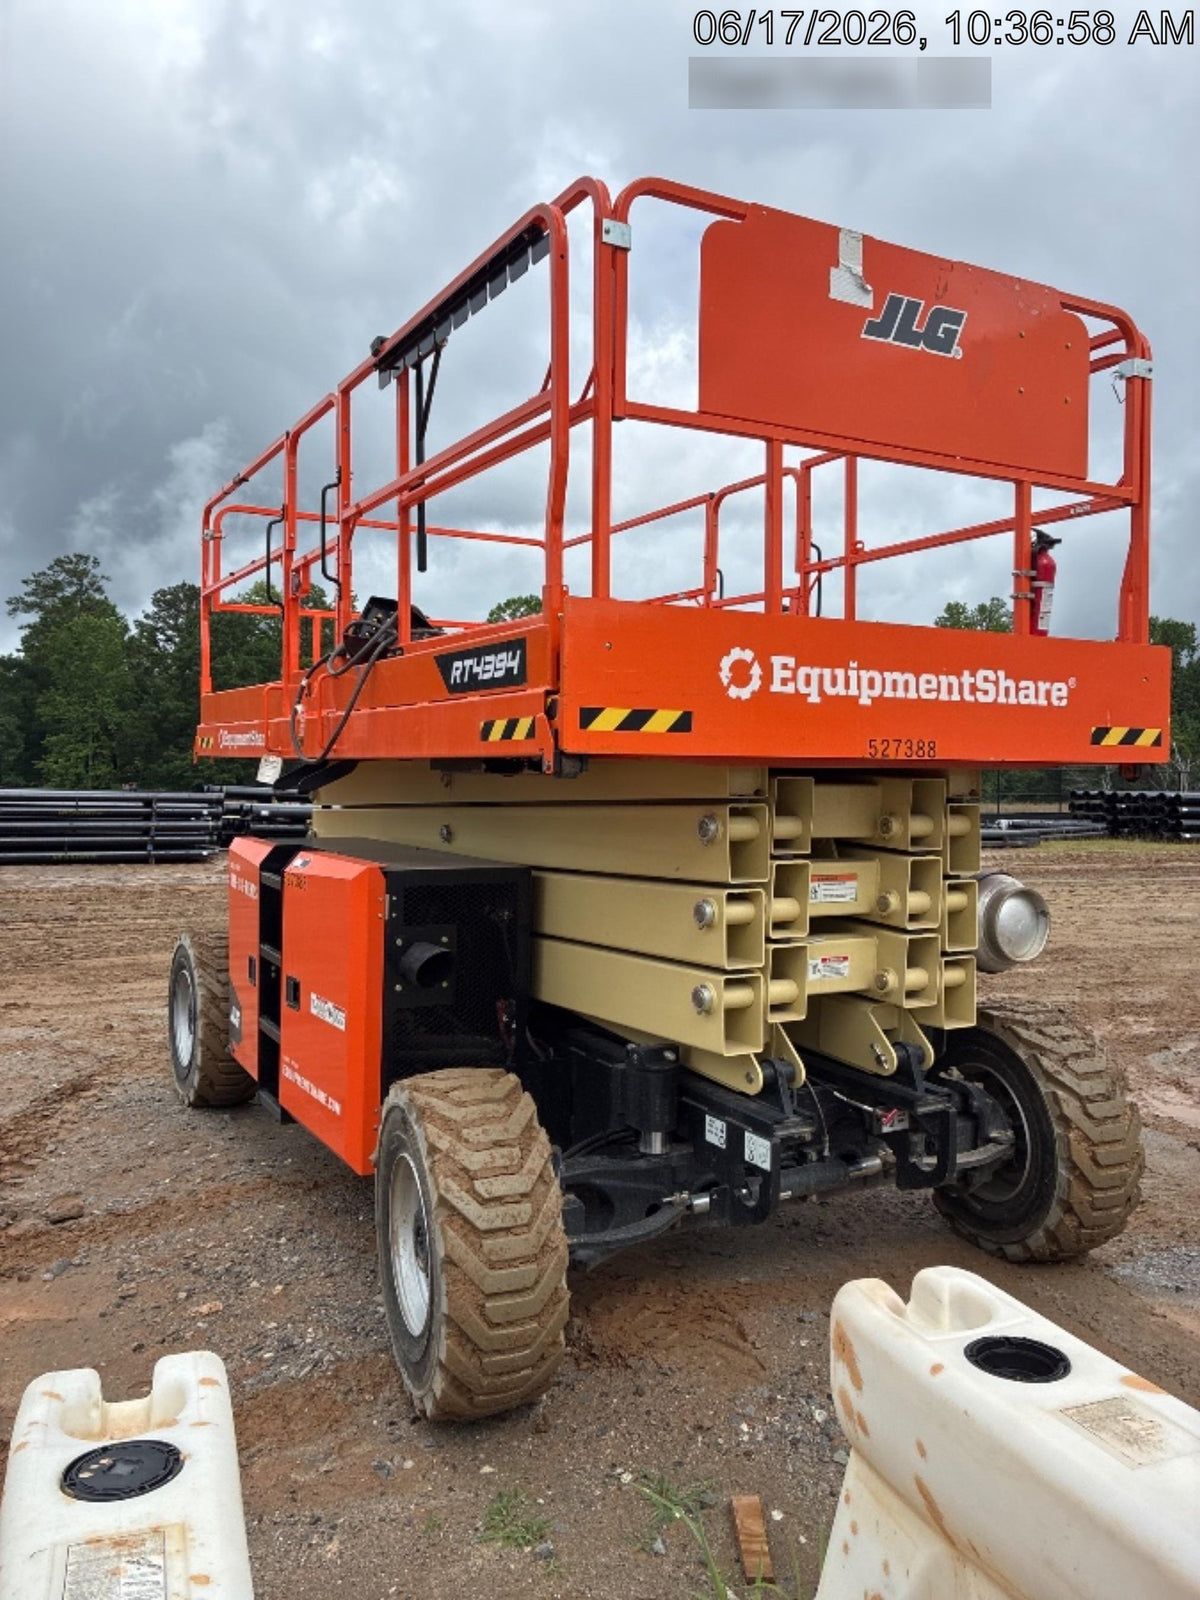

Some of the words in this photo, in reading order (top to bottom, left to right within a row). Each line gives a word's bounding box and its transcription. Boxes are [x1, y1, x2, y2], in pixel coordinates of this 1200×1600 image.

[860, 292, 967, 357] JLG
[450, 649, 521, 685] RT4394
[868, 739, 937, 759] 527388
